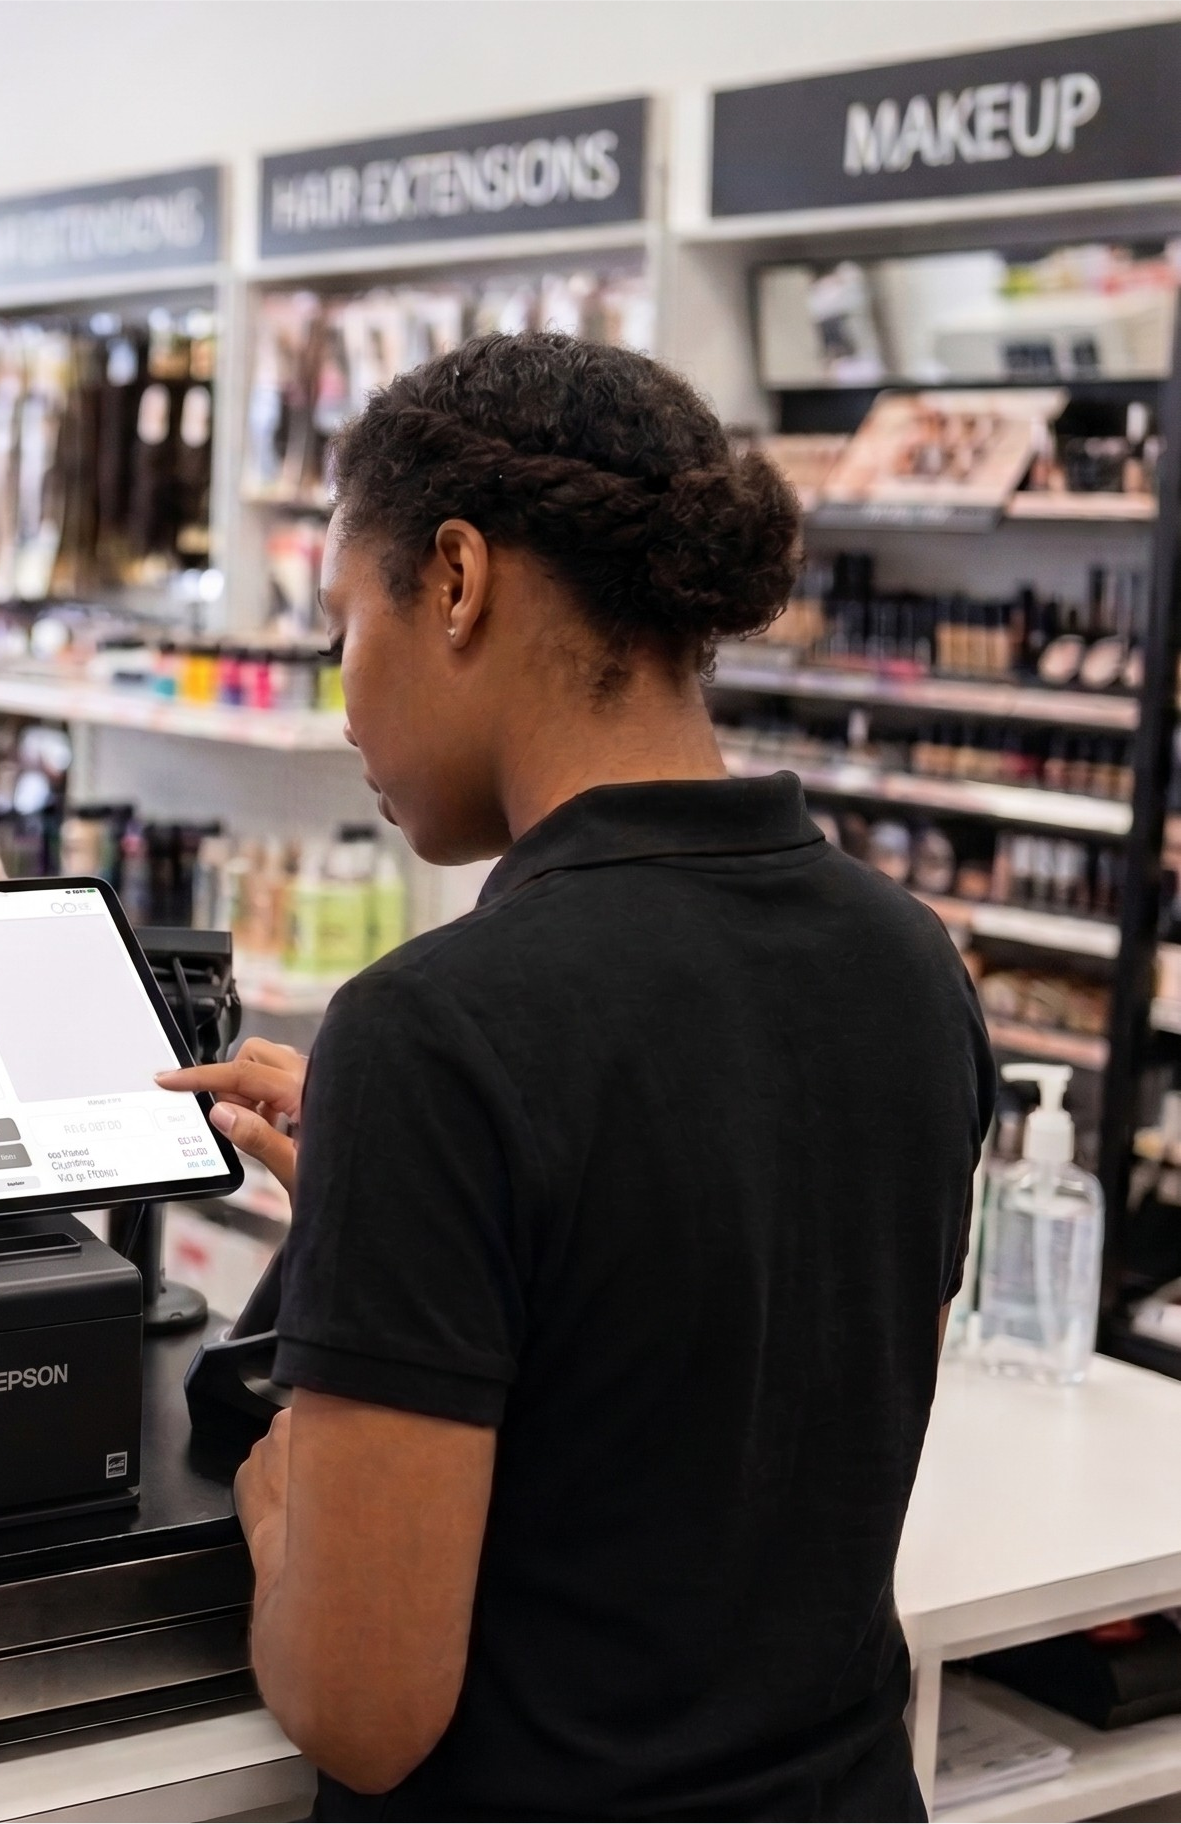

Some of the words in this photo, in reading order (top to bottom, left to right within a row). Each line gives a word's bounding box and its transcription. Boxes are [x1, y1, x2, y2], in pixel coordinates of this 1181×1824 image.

[843, 72, 1101, 176] MAKEUP
[271, 165, 360, 233] HAIR
[362, 129, 620, 225] EXTENSIONS
